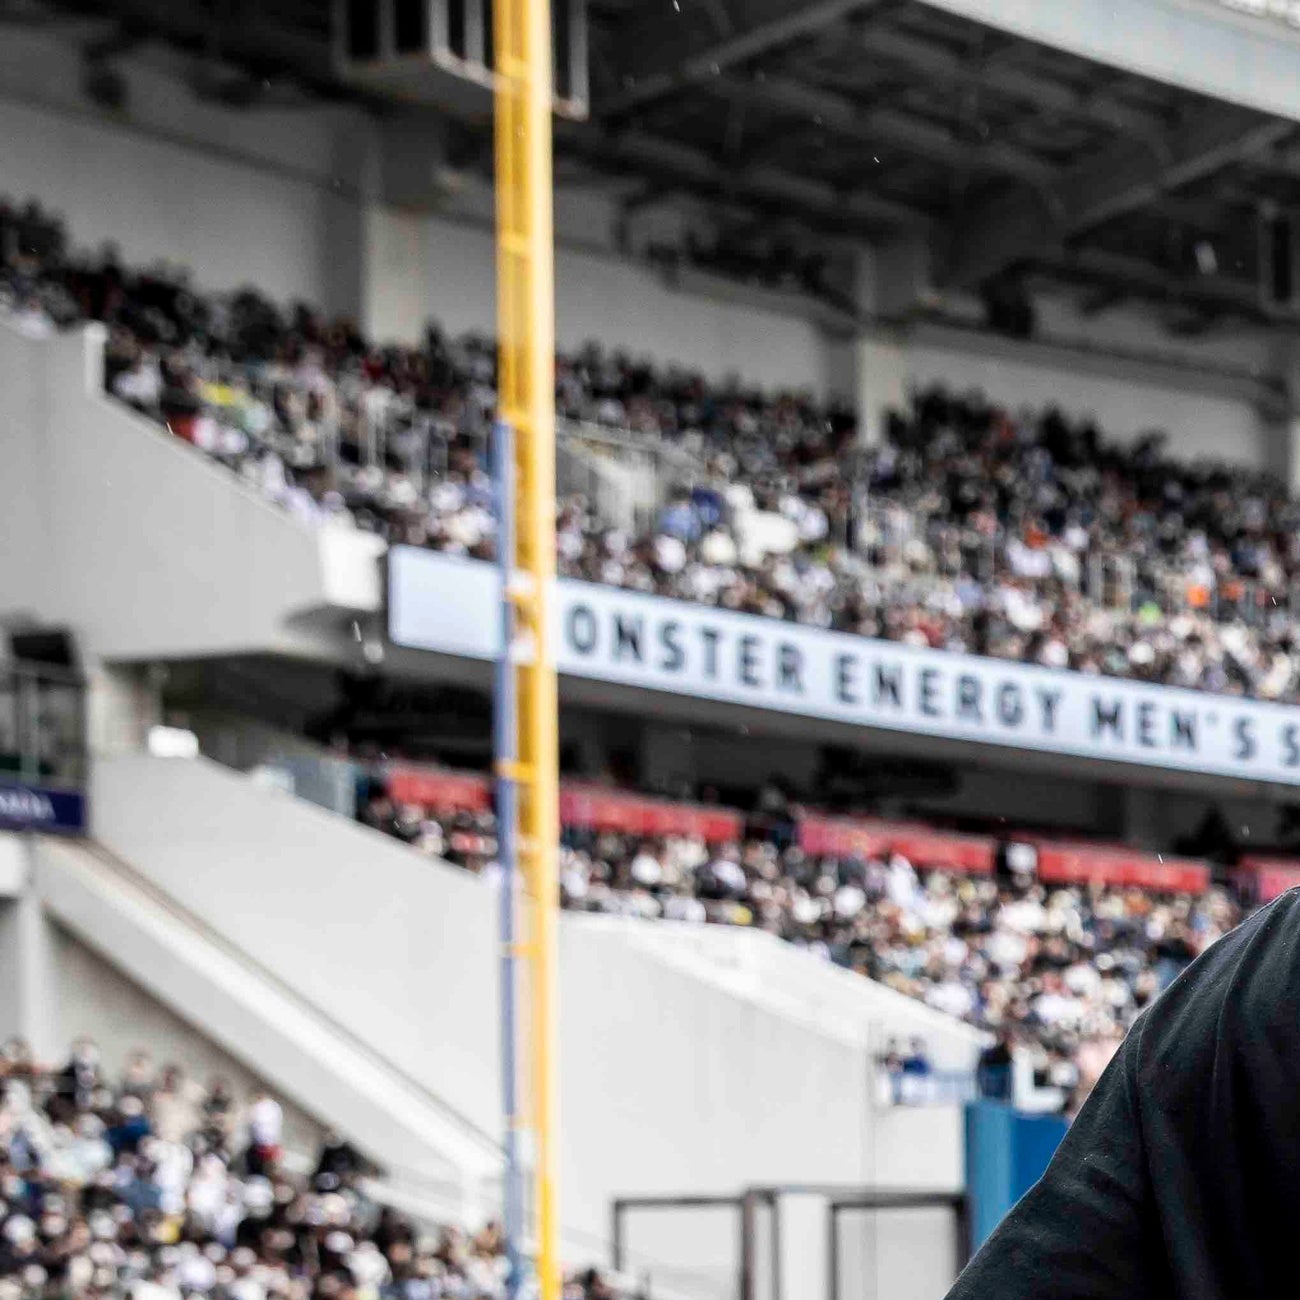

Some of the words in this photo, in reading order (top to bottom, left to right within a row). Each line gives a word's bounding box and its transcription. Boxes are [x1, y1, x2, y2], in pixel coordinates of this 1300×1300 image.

[568, 602, 805, 691] ONSTER
[834, 653, 1063, 733] ENERGY
[1090, 694, 1258, 761] MEN'S
